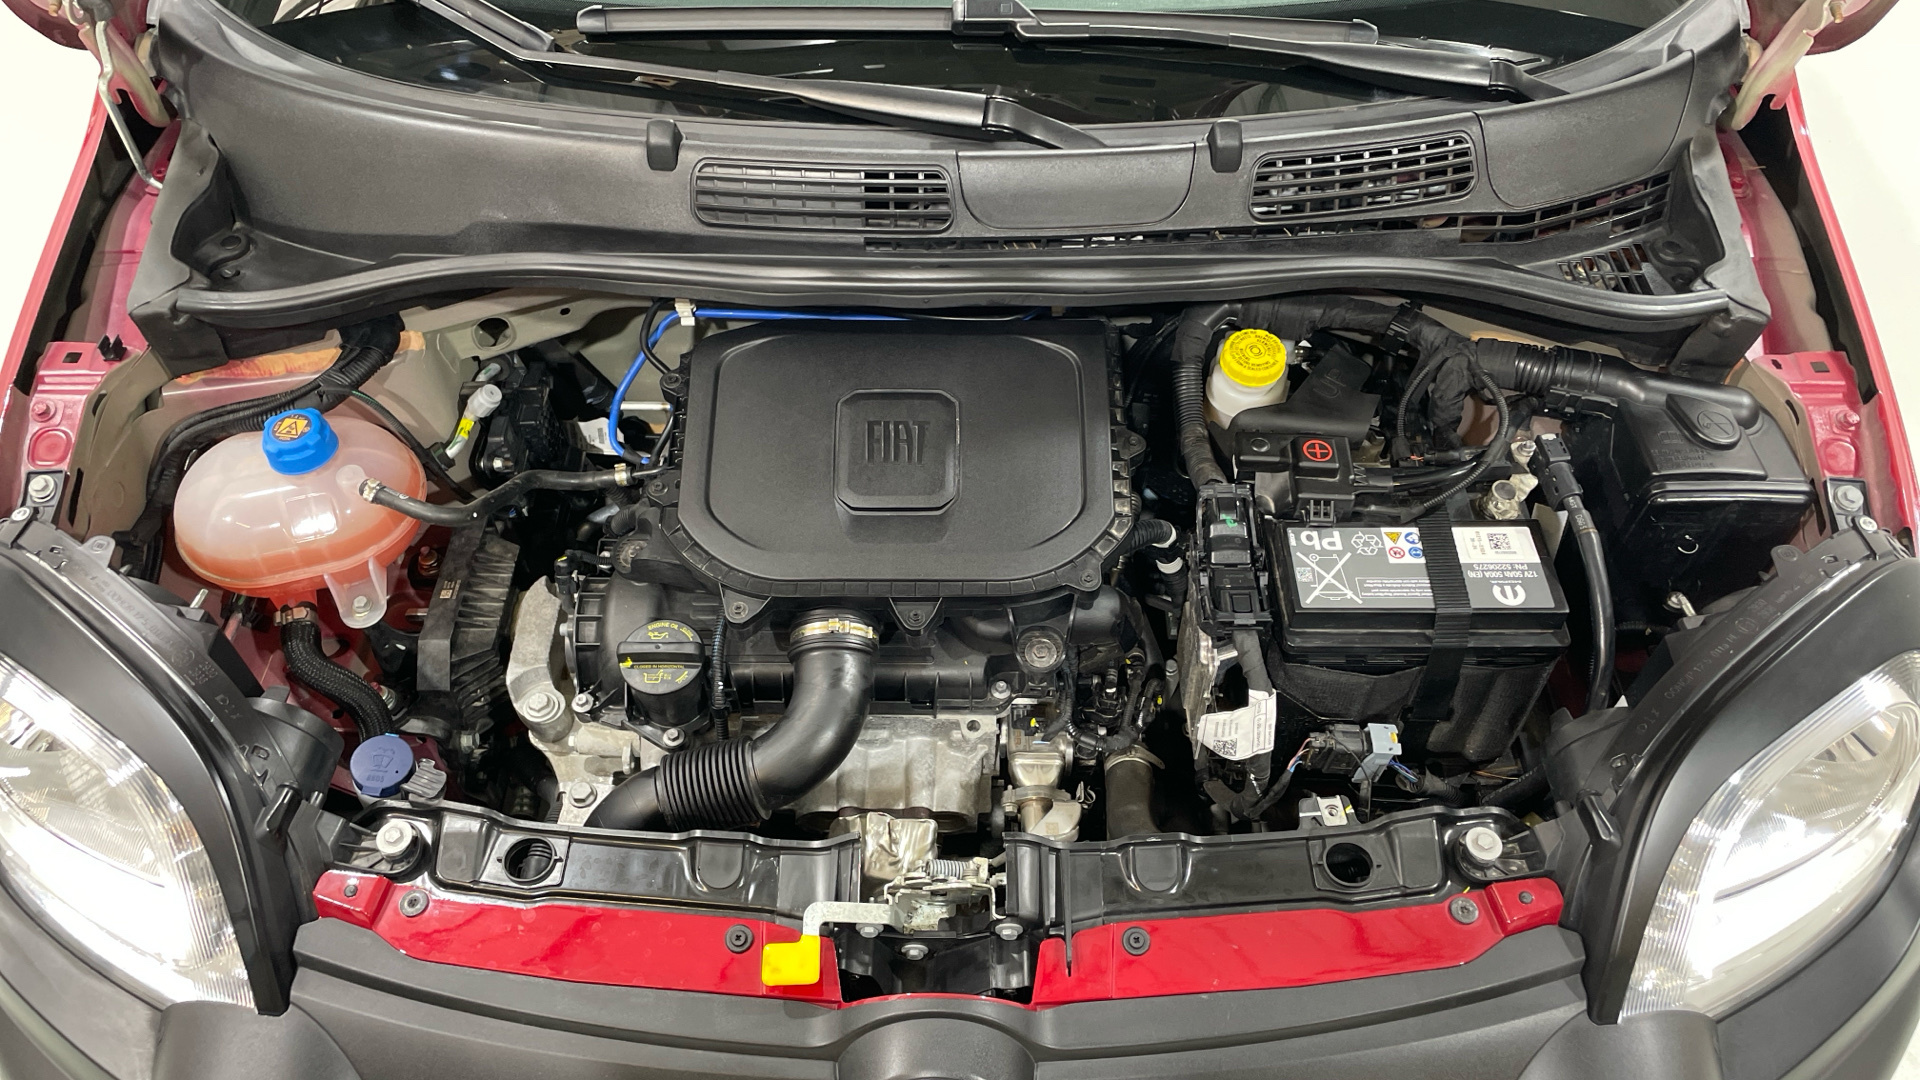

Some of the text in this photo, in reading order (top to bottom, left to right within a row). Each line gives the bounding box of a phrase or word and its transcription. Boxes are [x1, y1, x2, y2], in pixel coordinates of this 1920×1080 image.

[865, 420, 931, 467] FIAT
[1300, 530, 1343, 551] Pb
[1467, 569, 1538, 578] 12V 50Ah 500A (EN)
[647, 621, 679, 631] ENGINE OIL
